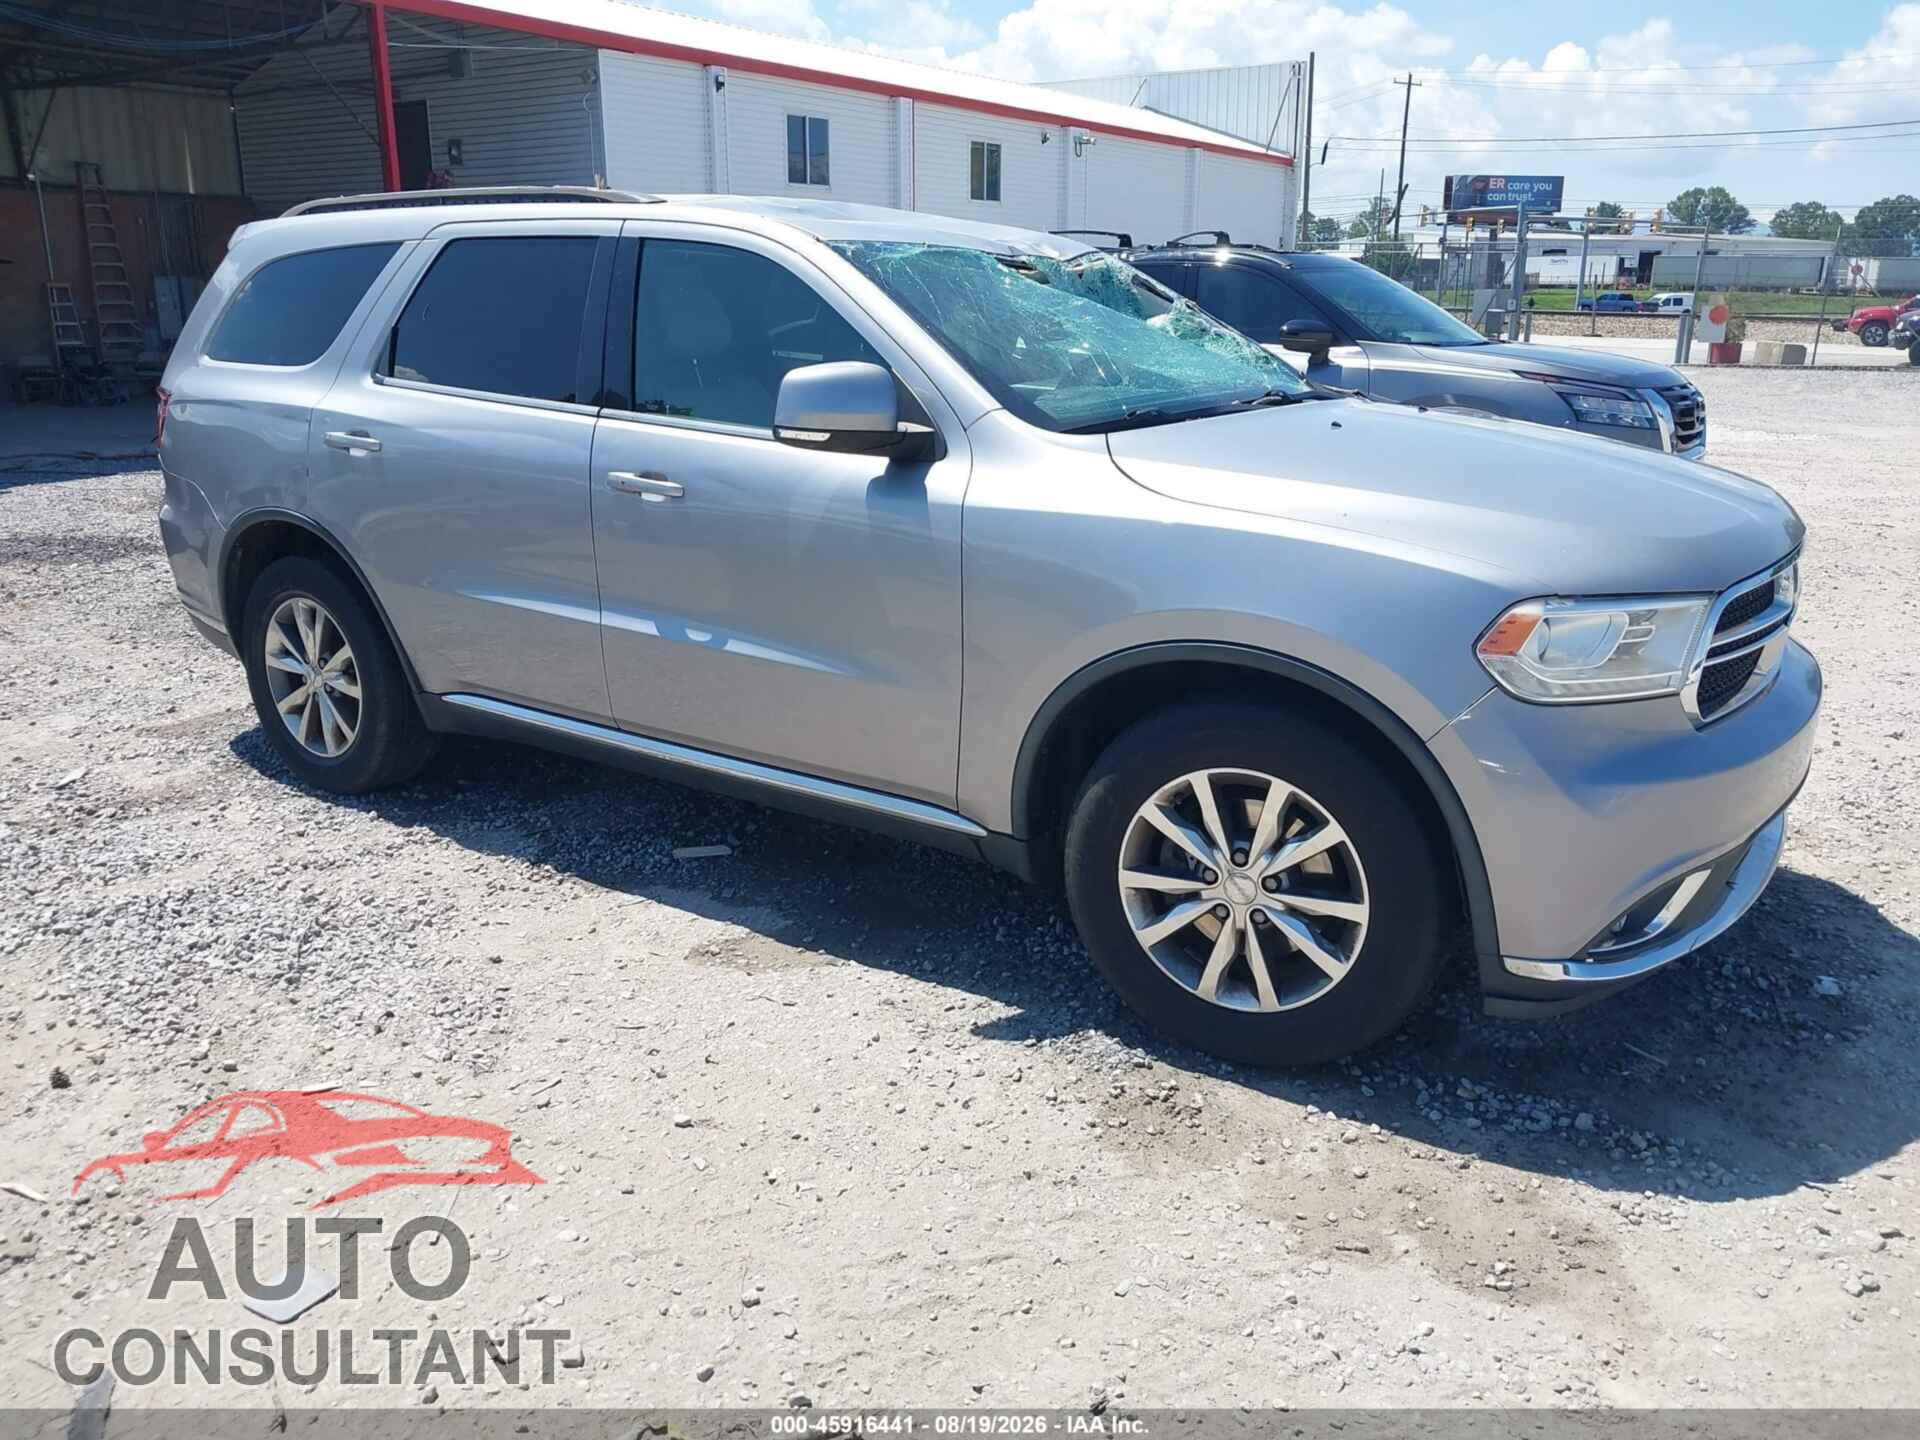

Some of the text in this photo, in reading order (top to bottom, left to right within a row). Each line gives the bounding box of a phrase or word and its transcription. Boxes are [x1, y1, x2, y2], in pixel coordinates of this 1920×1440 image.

[1489, 178, 1505, 189] ER
[1507, 181, 1530, 190] care
[1533, 182, 1552, 192] you
[1487, 191, 1535, 201] can trust.
